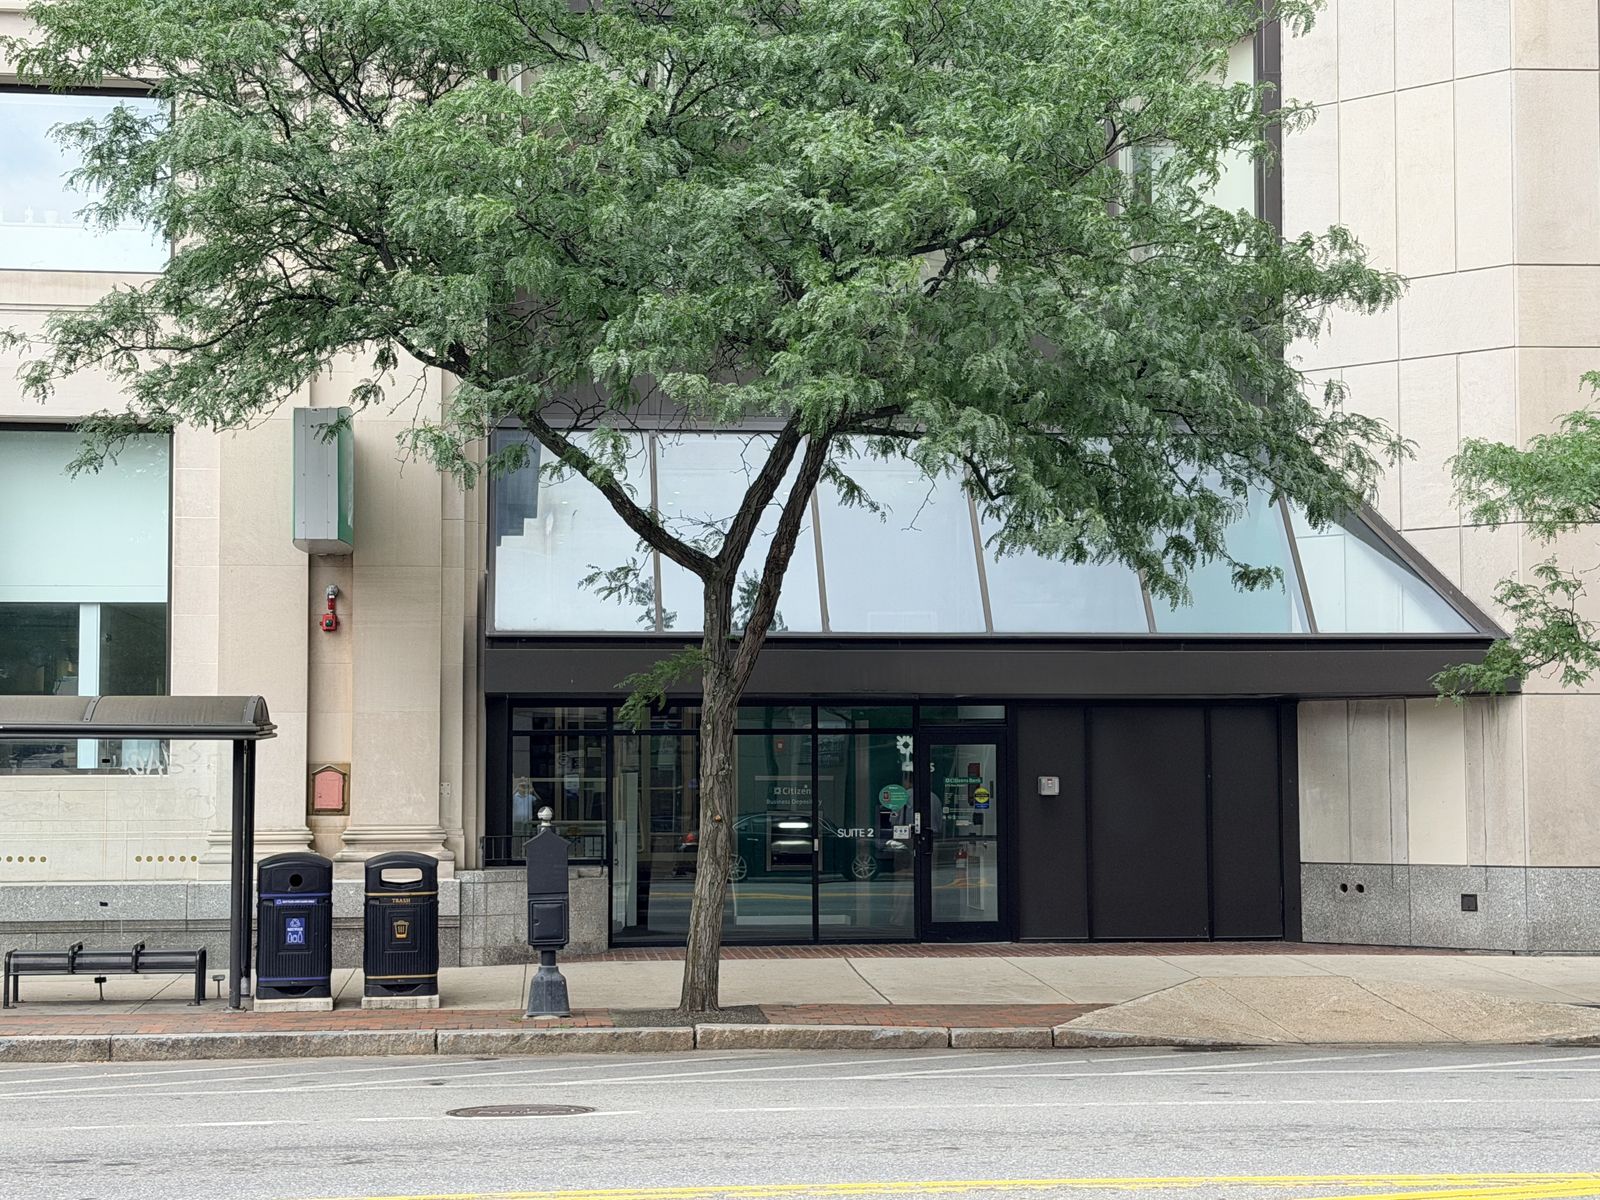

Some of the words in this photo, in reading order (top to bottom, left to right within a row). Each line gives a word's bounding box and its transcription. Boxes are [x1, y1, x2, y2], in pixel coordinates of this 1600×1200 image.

[782, 786, 812, 795] Citizen
[837, 828, 865, 838] SUITE
[867, 828, 875, 838] 2
